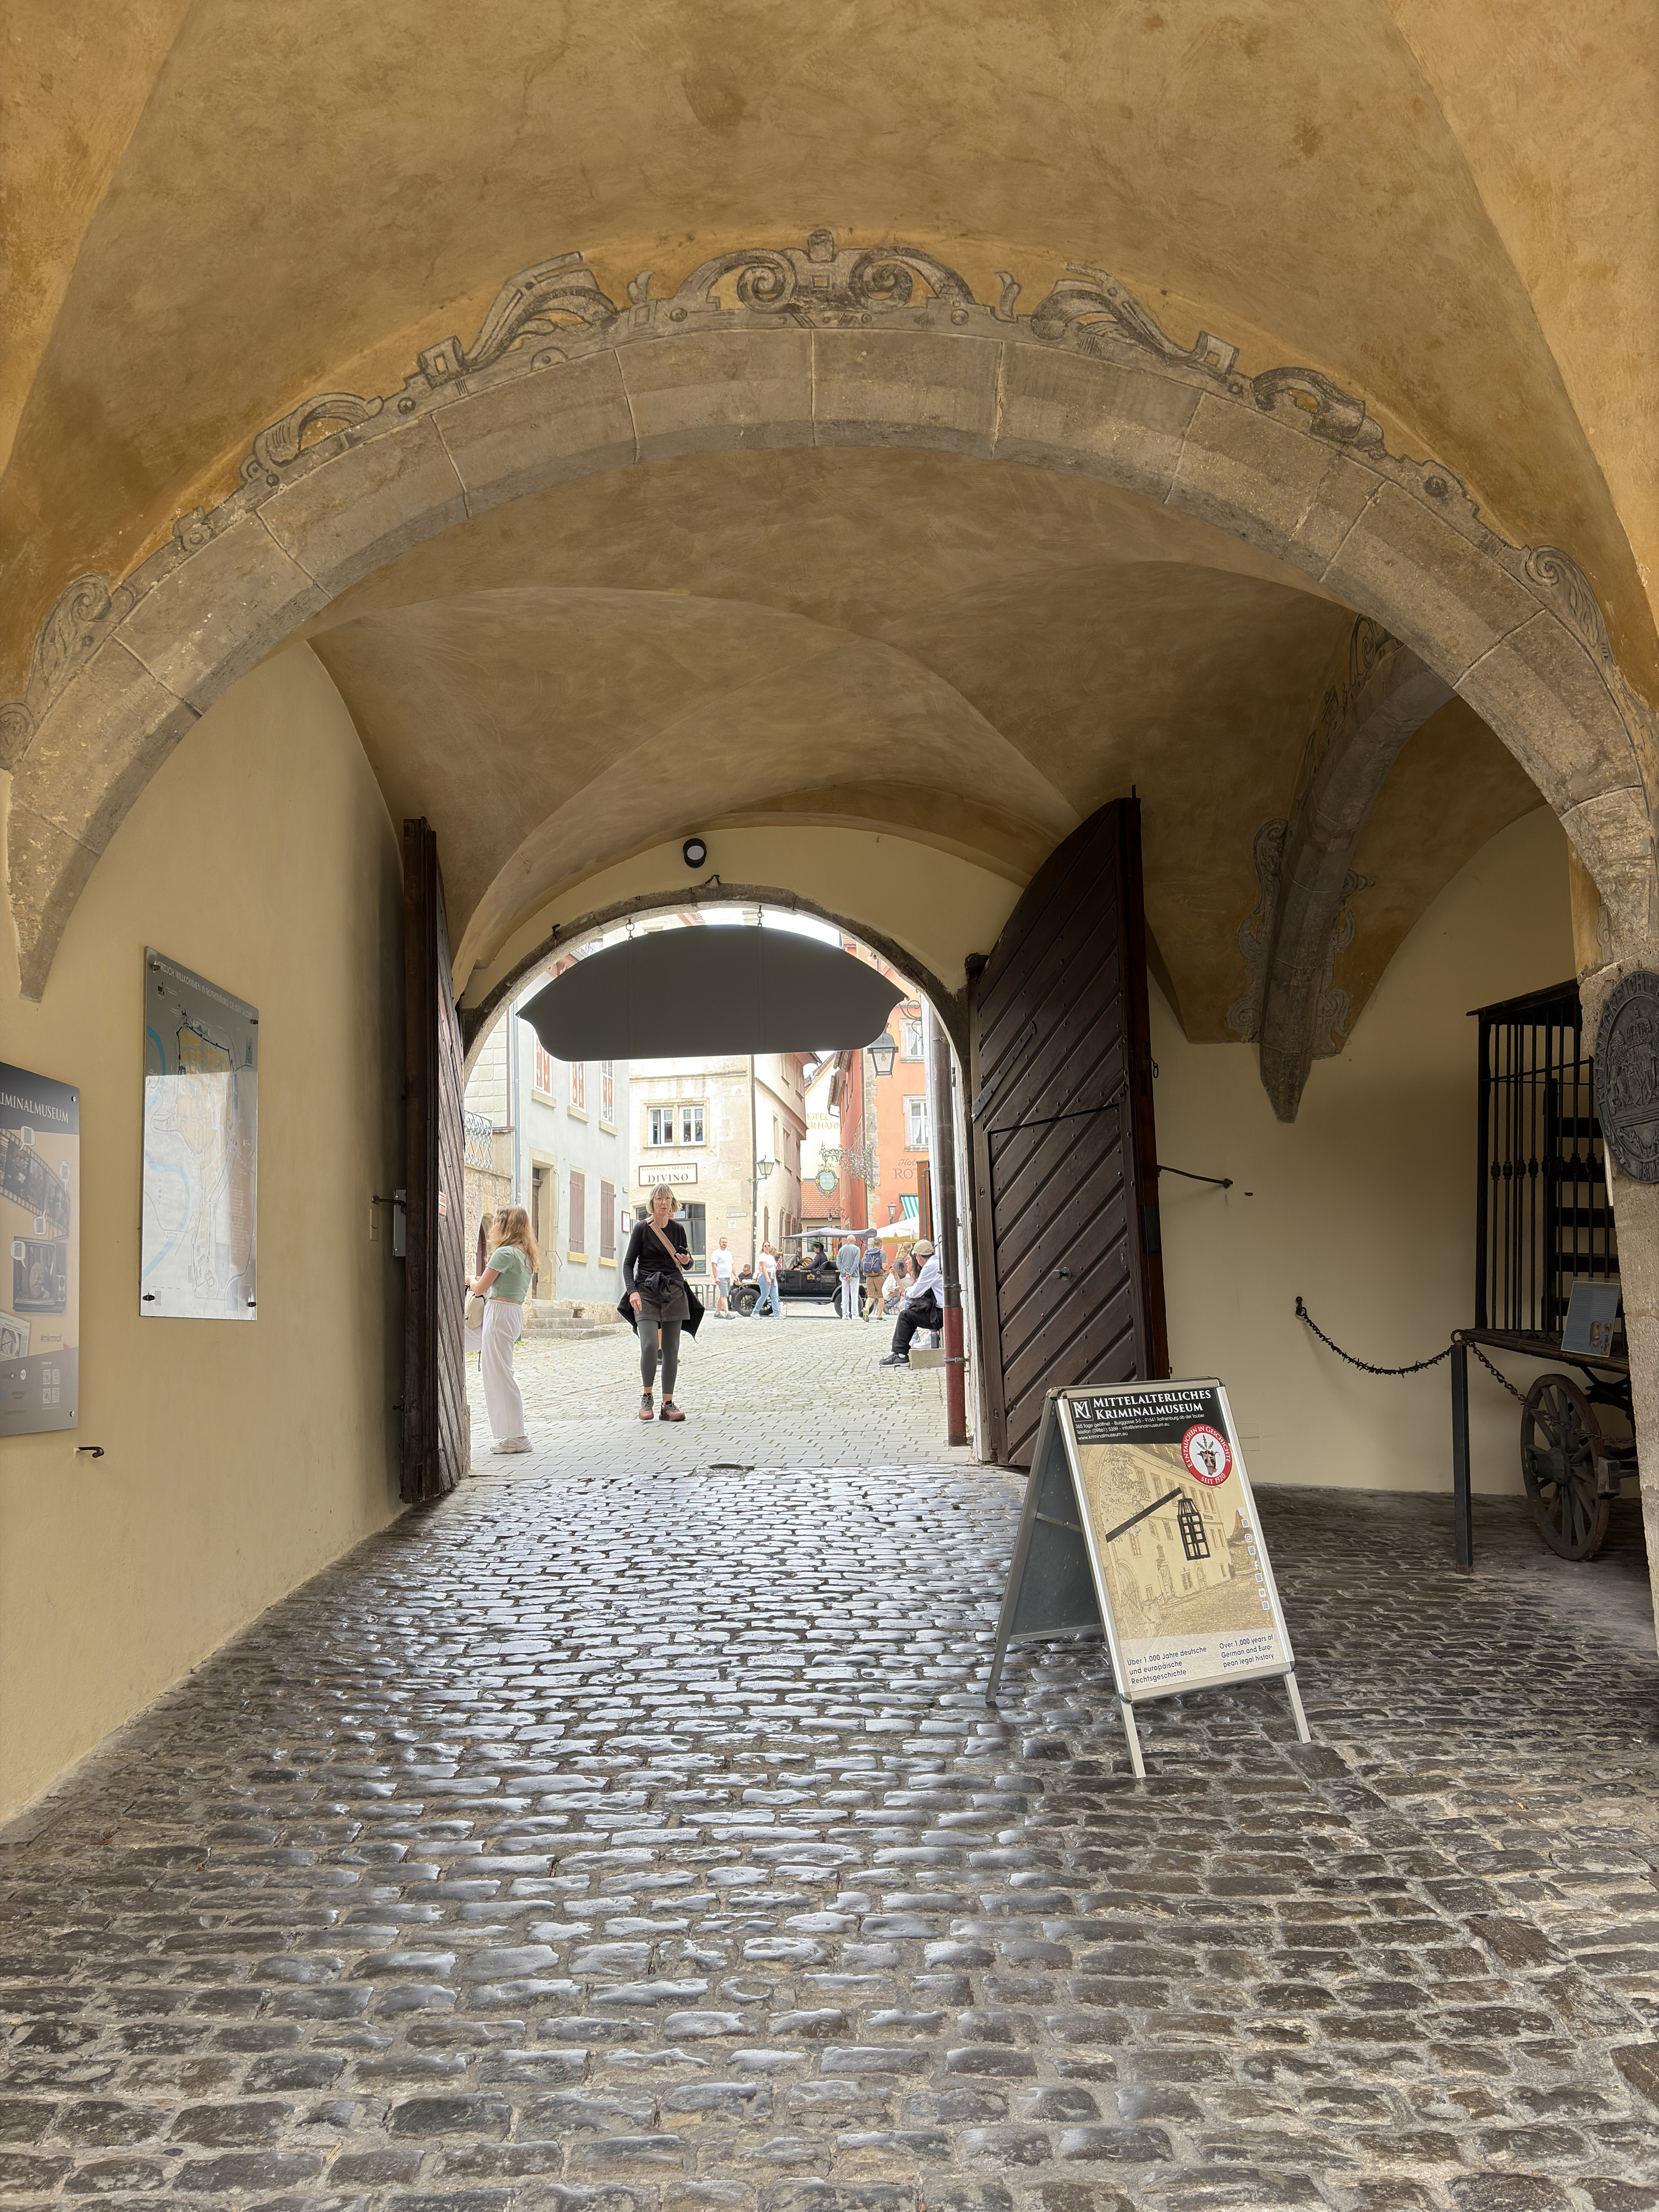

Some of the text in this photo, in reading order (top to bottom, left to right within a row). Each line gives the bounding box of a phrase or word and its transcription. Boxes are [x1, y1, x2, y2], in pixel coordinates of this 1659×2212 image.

[175, 970, 201, 990] WILLKOMMEN
[201, 984, 206, 994] IN
[206, 988, 229, 1006] ROTHENBURG
[648, 1173, 688, 1183] DIVINO
[1093, 1390, 1212, 1408] MITTELALTERLICHES
[1095, 1403, 1204, 1420] KRIMINALMUSEUM
[1078, 1432, 1128, 1440] www.kriminalmuseum.eu
[1183, 1428, 1198, 1468] EINTAUCHEN
[1206, 1426, 1230, 1463] GESCHICHTE
[1214, 1473, 1226, 1484] 1920
[1234, 1638, 1250, 1647] 1,000
[1251, 1636, 1266, 1645] years
[1127, 1657, 1142, 1666] Über
[1144, 1654, 1161, 1663] 1.000
[1180, 1647, 1207, 1656] deutsche
[1221, 1650, 1245, 1658] German
[1129, 1661, 1182, 1675] und europäische
[1223, 1660, 1238, 1668] pean
[1239, 1656, 1254, 1665] legal
[1131, 1669, 1187, 1684] Rechtsgeschichte
